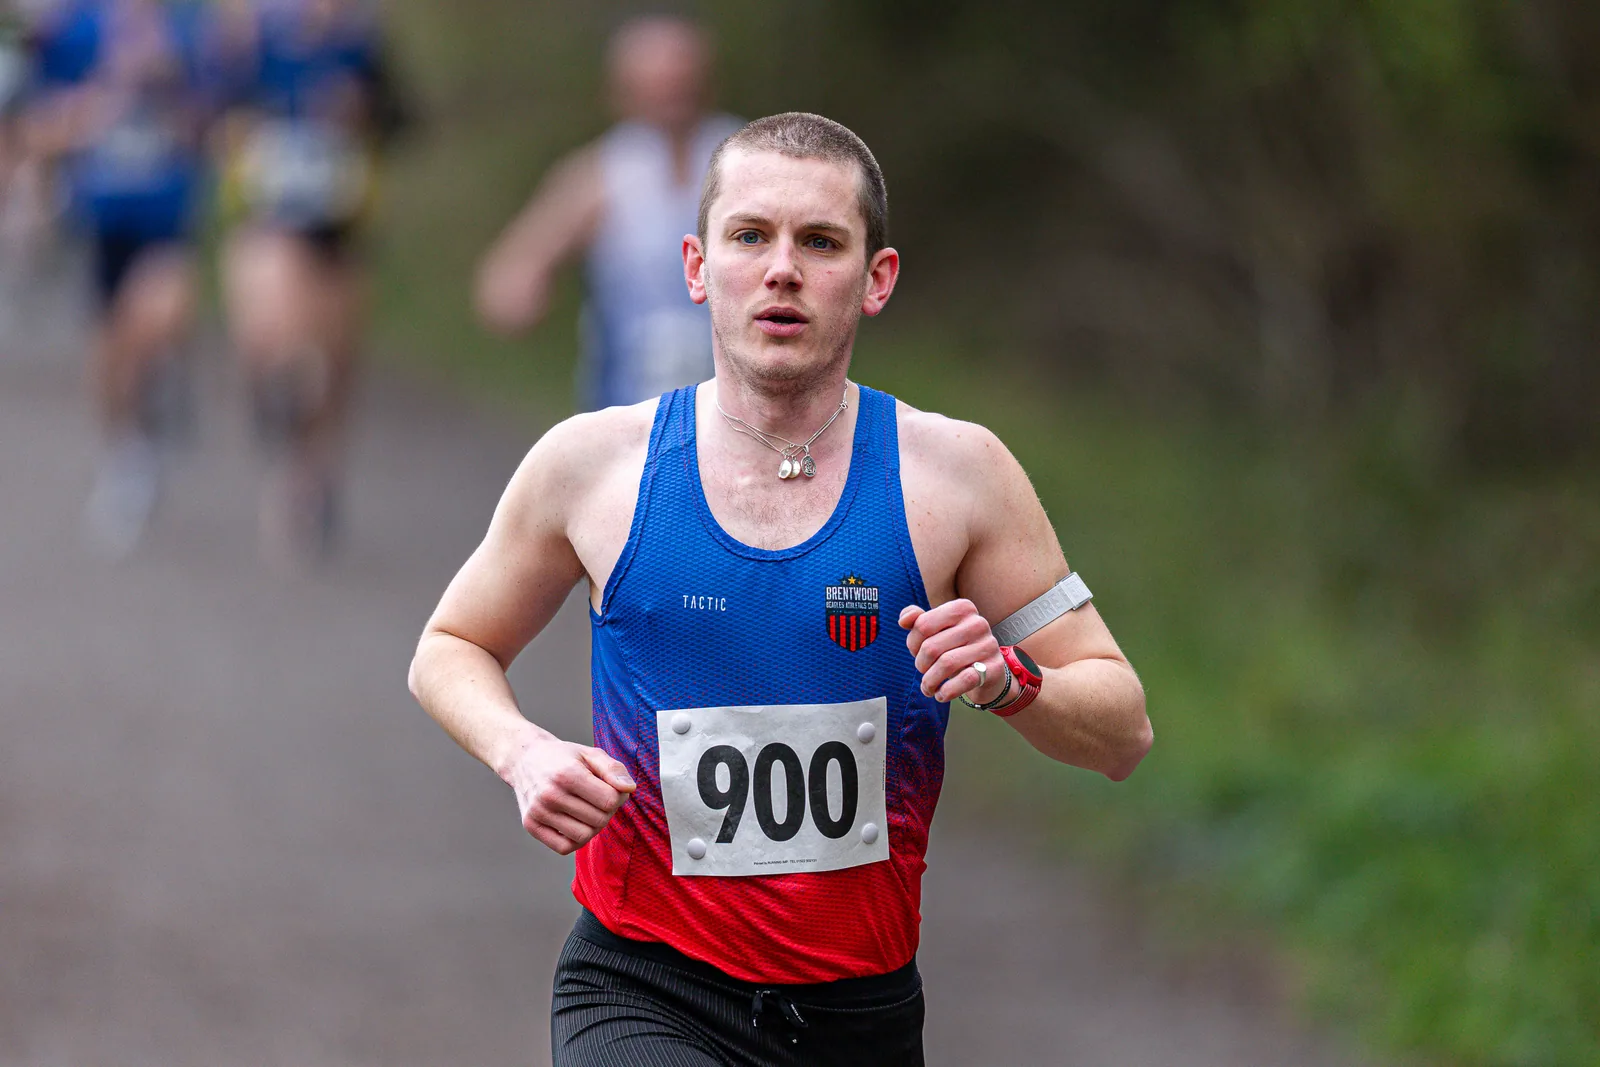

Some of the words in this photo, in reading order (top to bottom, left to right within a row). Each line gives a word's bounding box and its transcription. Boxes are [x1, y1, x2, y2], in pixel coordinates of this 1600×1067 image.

[682, 594, 727, 612] TACTIC
[826, 587, 878, 601] BRENTWOOD
[696, 740, 859, 844] 900
